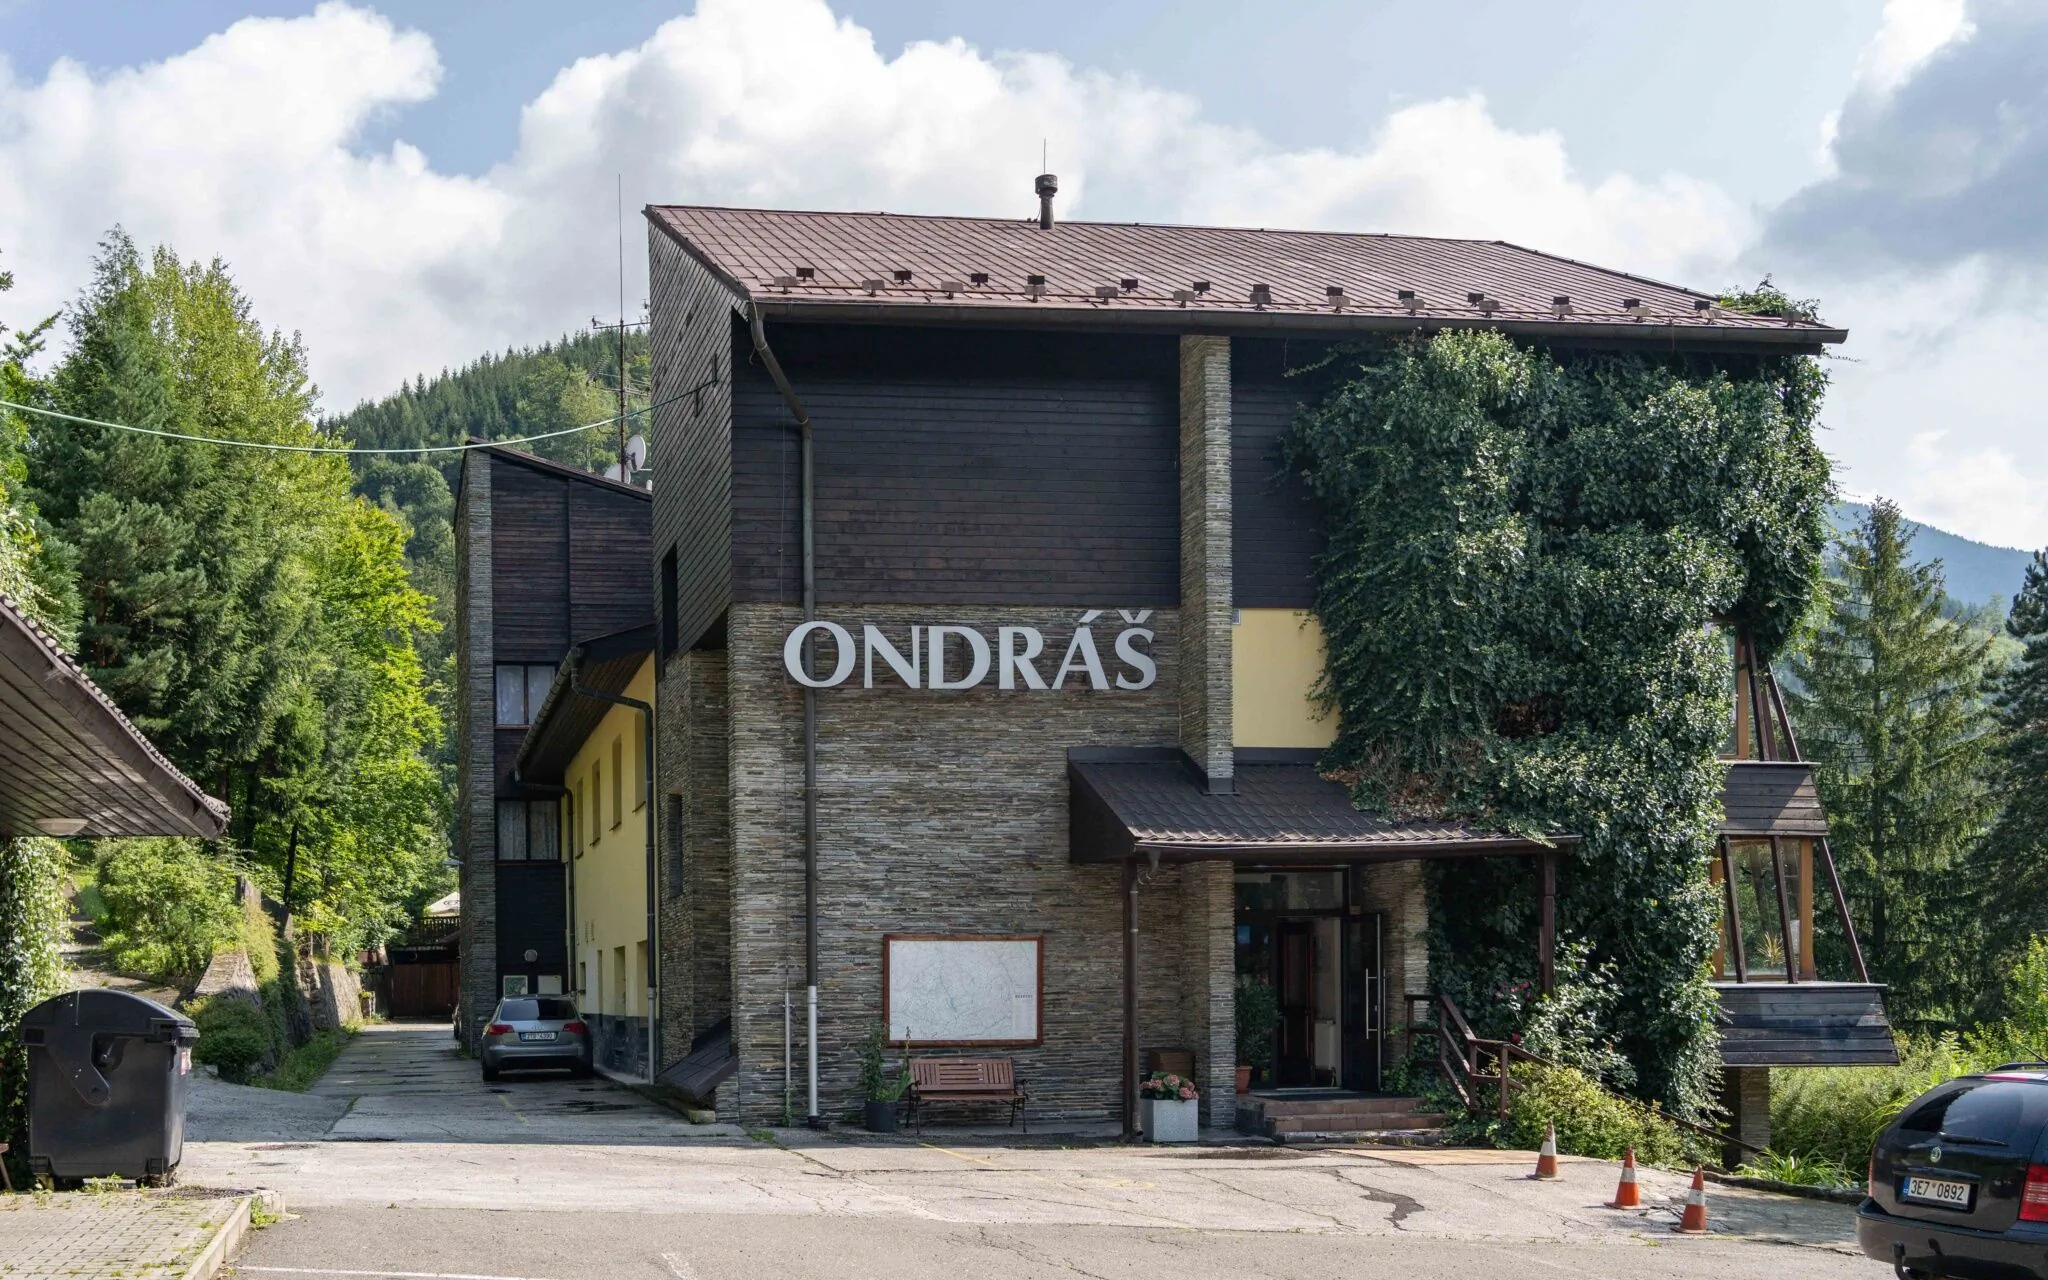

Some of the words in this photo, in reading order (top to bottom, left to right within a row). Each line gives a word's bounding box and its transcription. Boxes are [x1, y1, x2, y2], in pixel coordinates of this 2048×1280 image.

[783, 609, 1157, 690] ONDRÁŠ
[1911, 1179, 1930, 1196] 3E7
[1936, 1183, 1965, 1201] 0892
